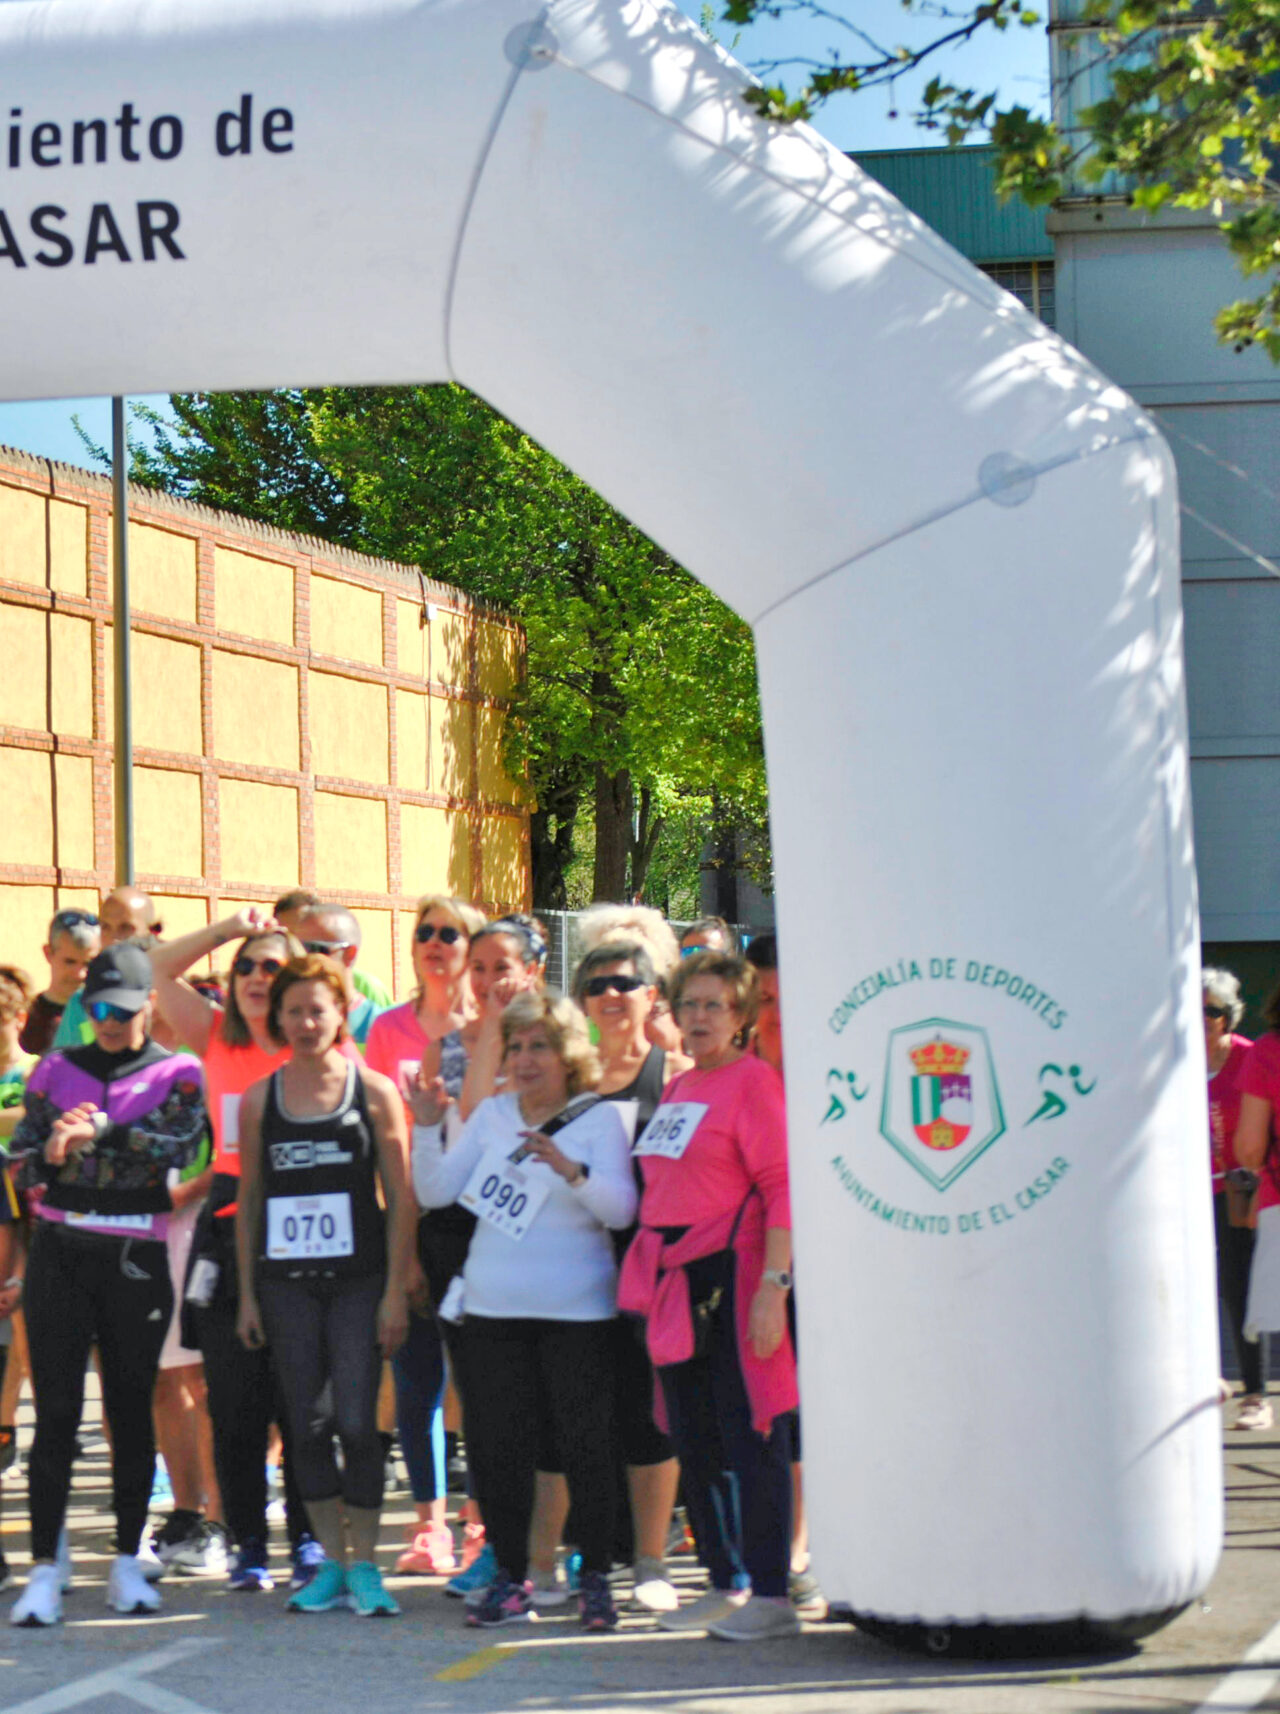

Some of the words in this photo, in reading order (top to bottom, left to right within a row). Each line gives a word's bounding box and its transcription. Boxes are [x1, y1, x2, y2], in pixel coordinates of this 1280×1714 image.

[215, 93, 294, 157] de
[827, 957, 922, 1036] CONCEJALÍA
[928, 957, 958, 980] DE
[964, 960, 1068, 1031] DEPORTES
[282, 1212, 335, 1242] 070
[480, 1174, 527, 1218] 090
[829, 1155, 950, 1235] AYUNTAMIENTO
[958, 1210, 983, 1234] DE
[989, 1203, 1015, 1226] EL
[1015, 1156, 1071, 1211] CASAR
